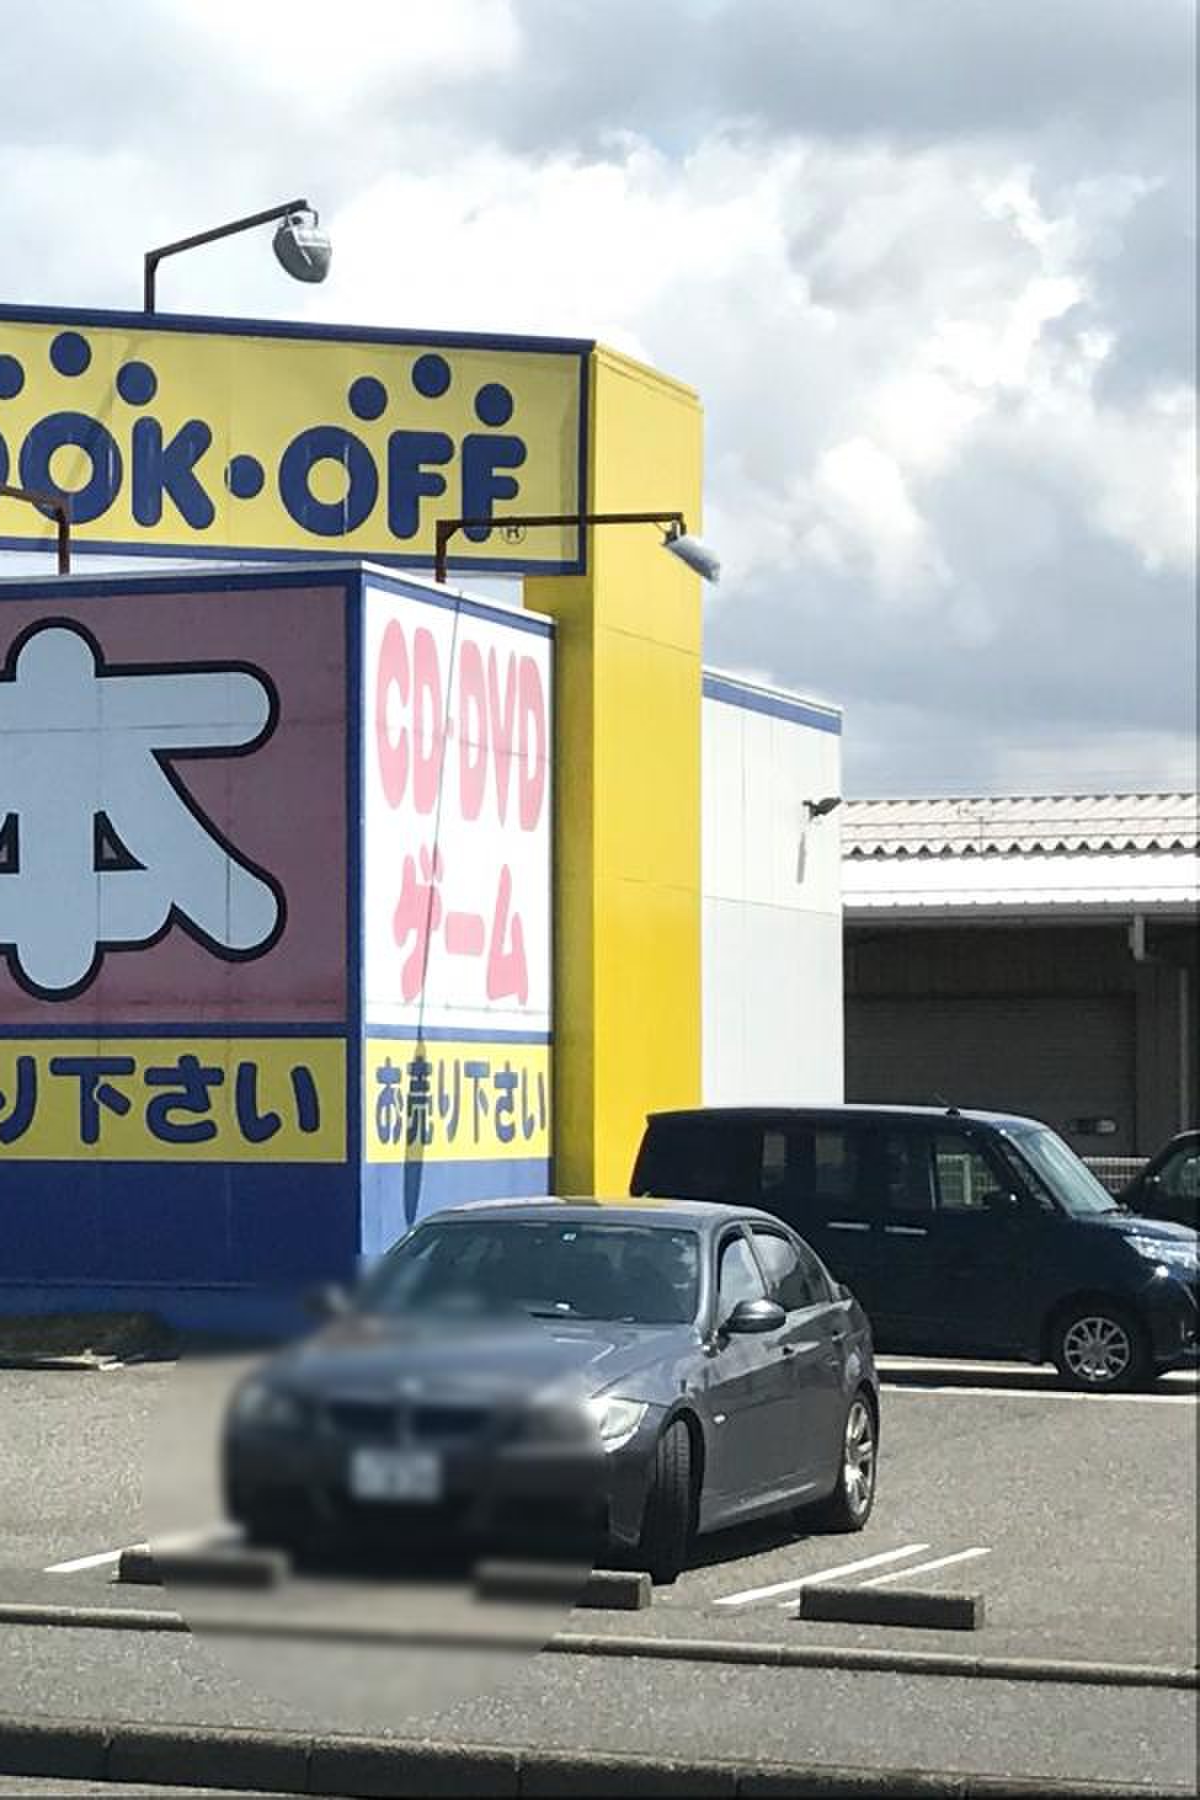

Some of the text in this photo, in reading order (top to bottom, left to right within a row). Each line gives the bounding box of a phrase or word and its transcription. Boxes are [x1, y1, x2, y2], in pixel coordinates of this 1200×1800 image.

[393, 844, 528, 1006] ゲーム
[376, 1057, 546, 1145] お売り下さい
